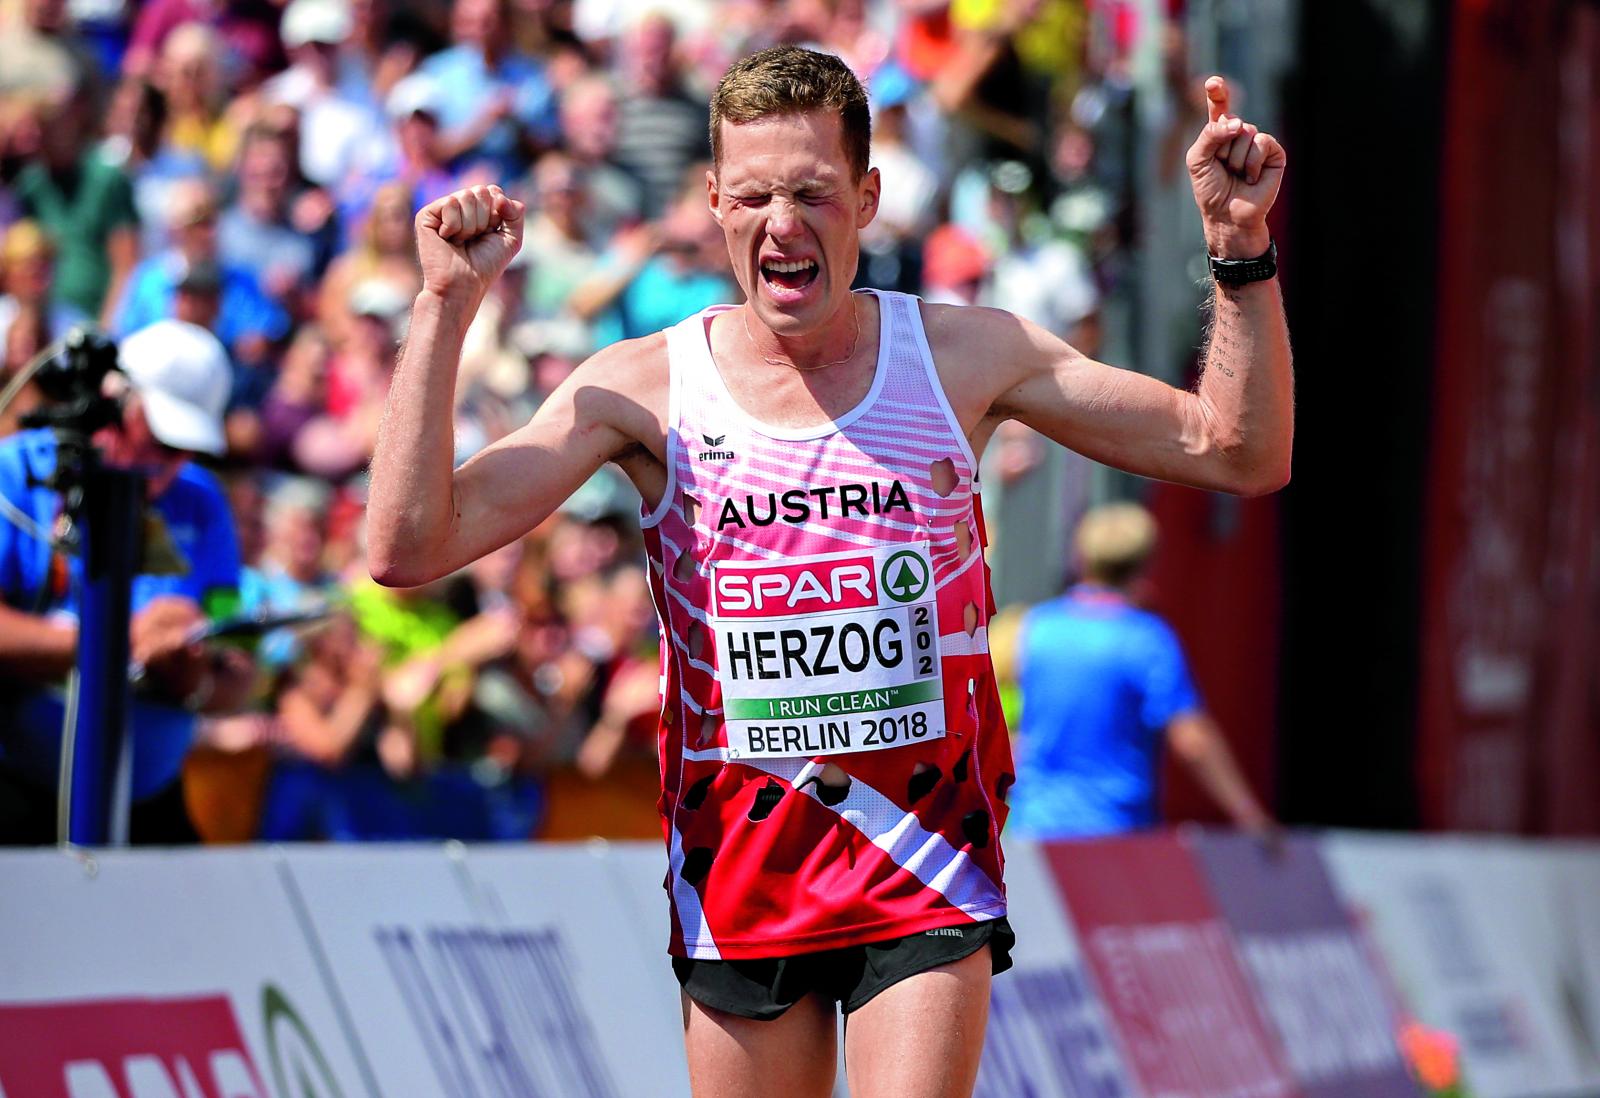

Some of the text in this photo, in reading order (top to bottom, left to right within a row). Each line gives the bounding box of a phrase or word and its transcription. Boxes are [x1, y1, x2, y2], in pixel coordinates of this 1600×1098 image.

[699, 449, 735, 462] erima
[717, 479, 914, 531] AUSTRIA
[717, 564, 874, 611] SPAR
[727, 618, 904, 680] HERZOG
[769, 701, 775, 717] I
[780, 698, 822, 716] RUN
[747, 711, 928, 753] BERLIN 2018
